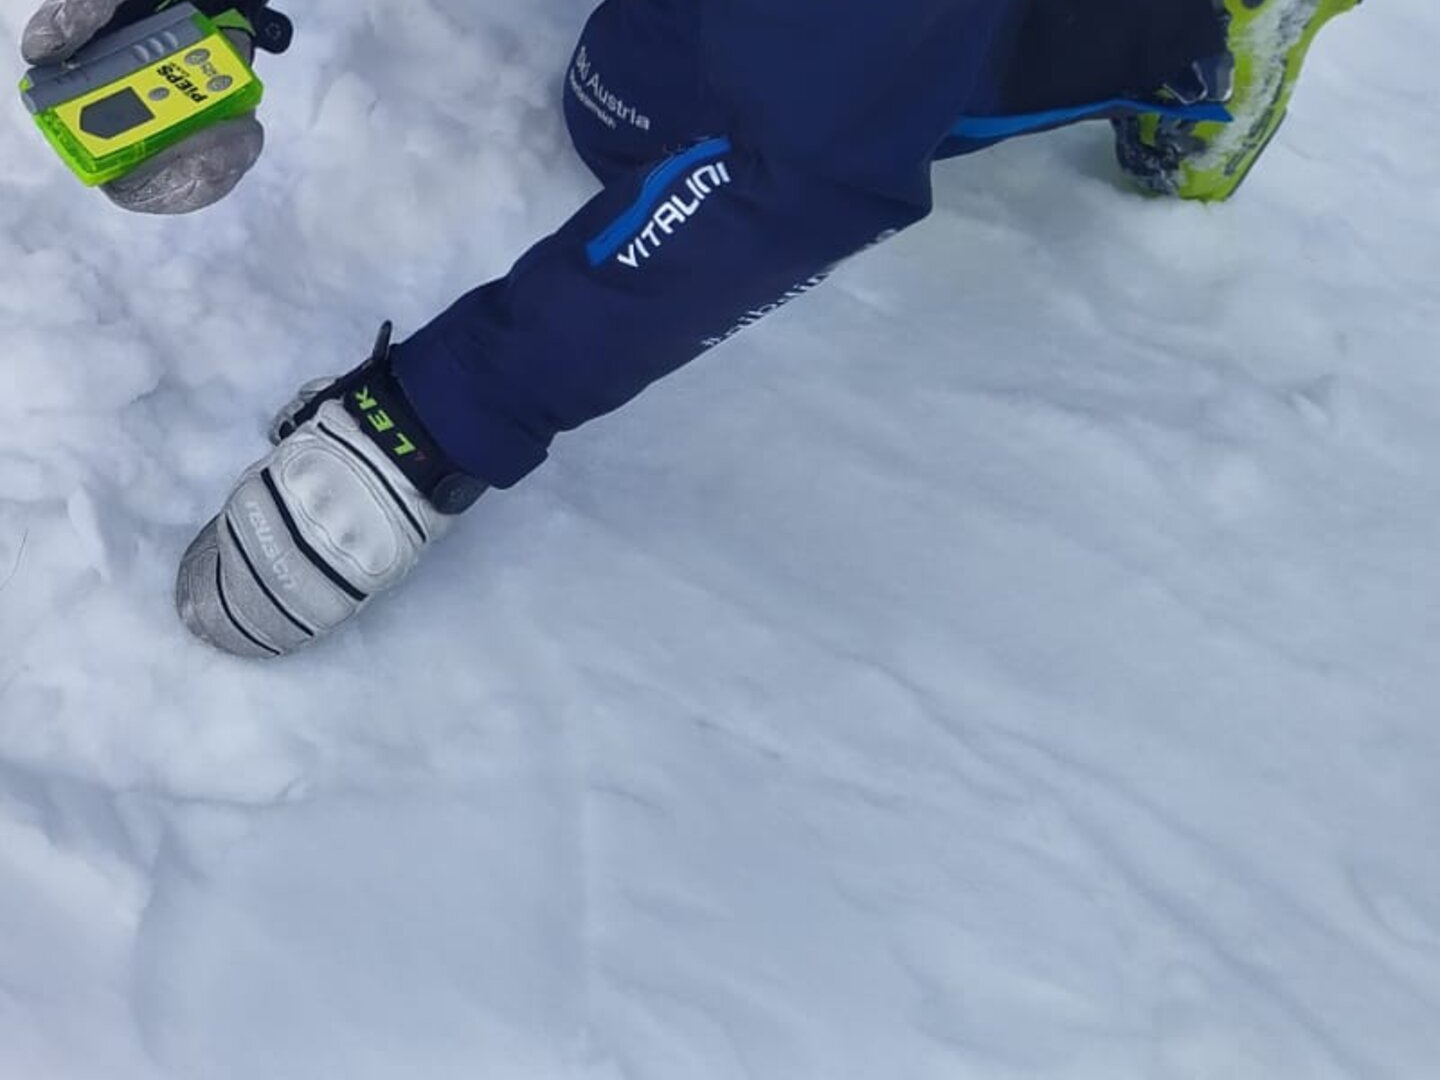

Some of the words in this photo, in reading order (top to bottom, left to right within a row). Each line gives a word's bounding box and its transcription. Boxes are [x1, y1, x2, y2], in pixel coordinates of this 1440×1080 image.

[585, 72, 651, 131] Austria
[617, 162, 731, 268] VITALINI
[355, 385, 416, 456] LEK
